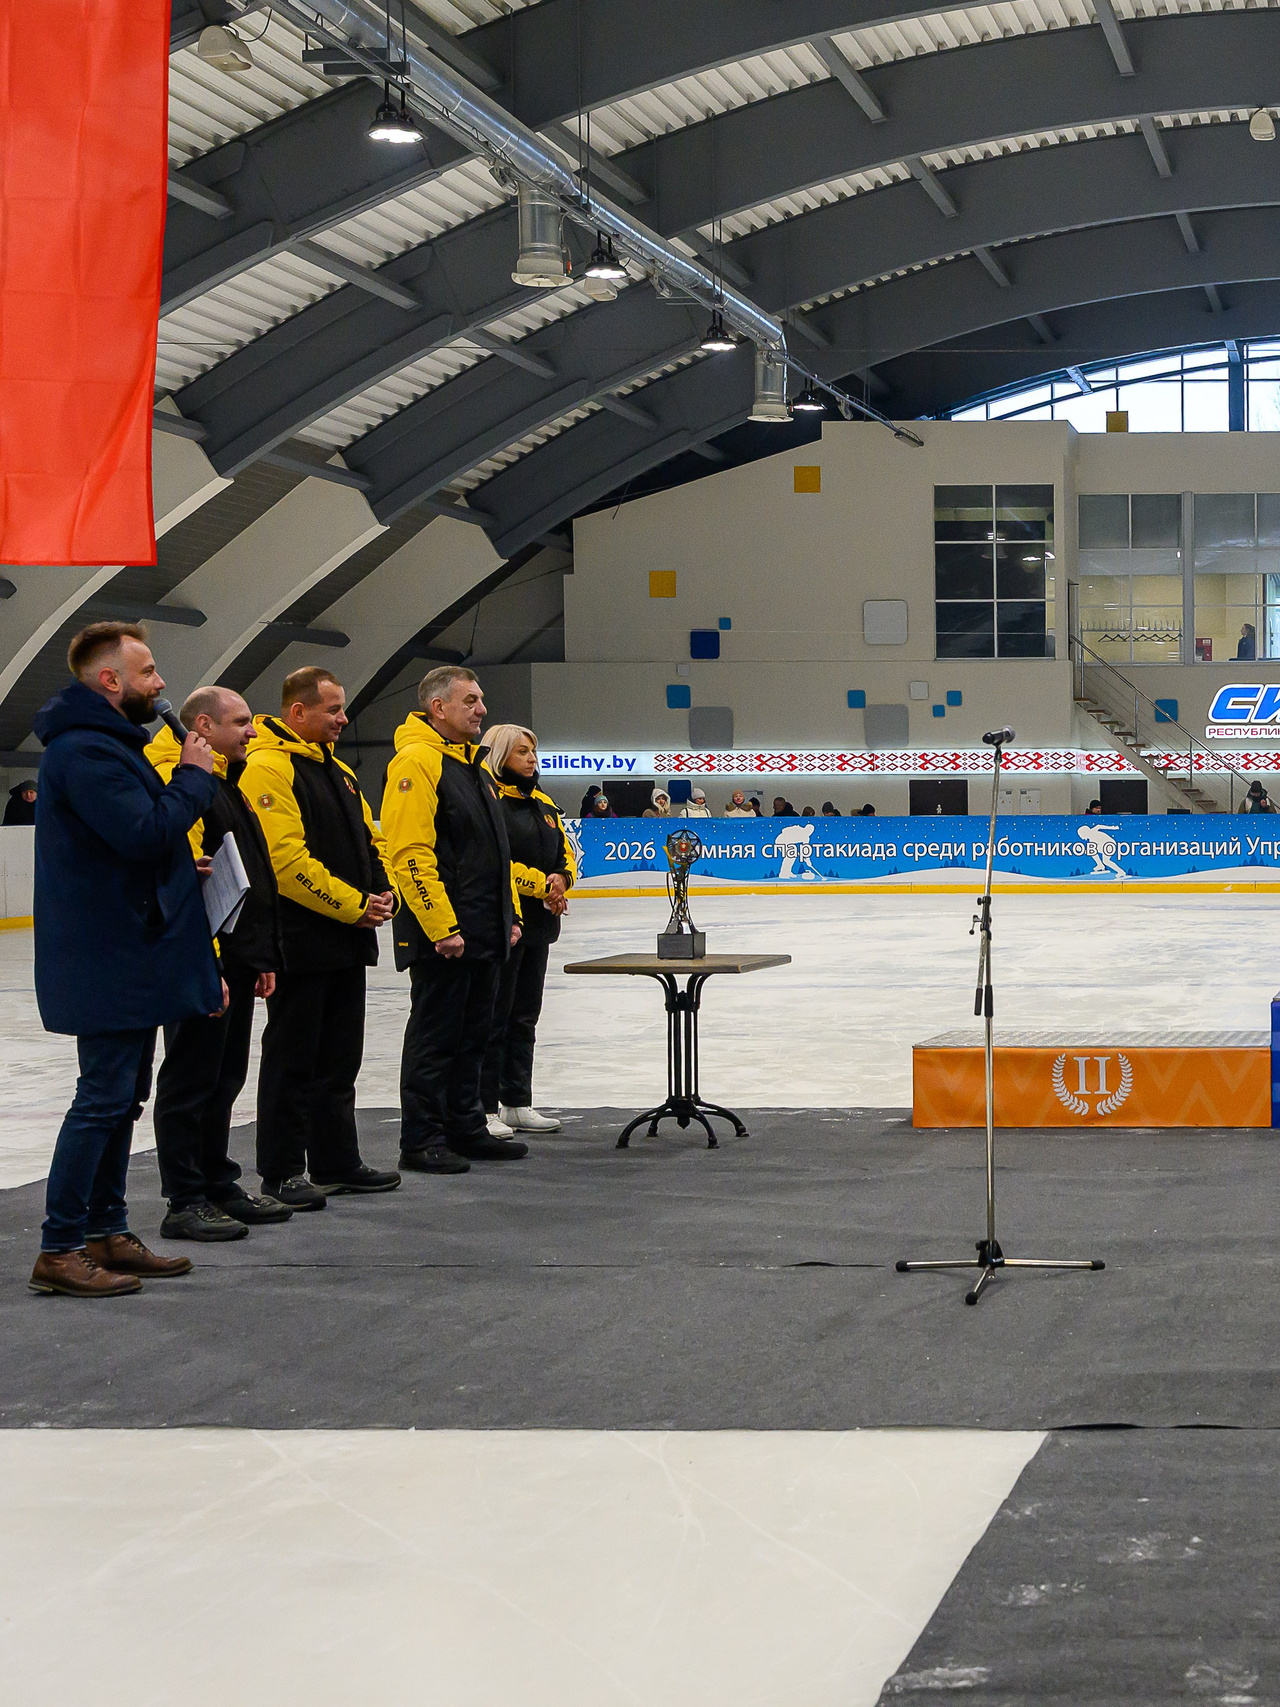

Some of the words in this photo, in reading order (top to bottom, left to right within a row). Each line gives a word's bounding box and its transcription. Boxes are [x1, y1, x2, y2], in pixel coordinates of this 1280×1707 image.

[541, 754, 637, 772] silichy.by
[604, 840, 656, 862] 2026
[701, 842, 756, 860] мняя
[761, 841, 897, 862] спартакиада
[903, 841, 965, 861] среди
[971, 835, 1098, 862] работников
[1103, 836, 1241, 860] организаций
[295, 872, 343, 910] BELARUS
[407, 858, 434, 911] BELARUS
[515, 876, 537, 889] RUS
